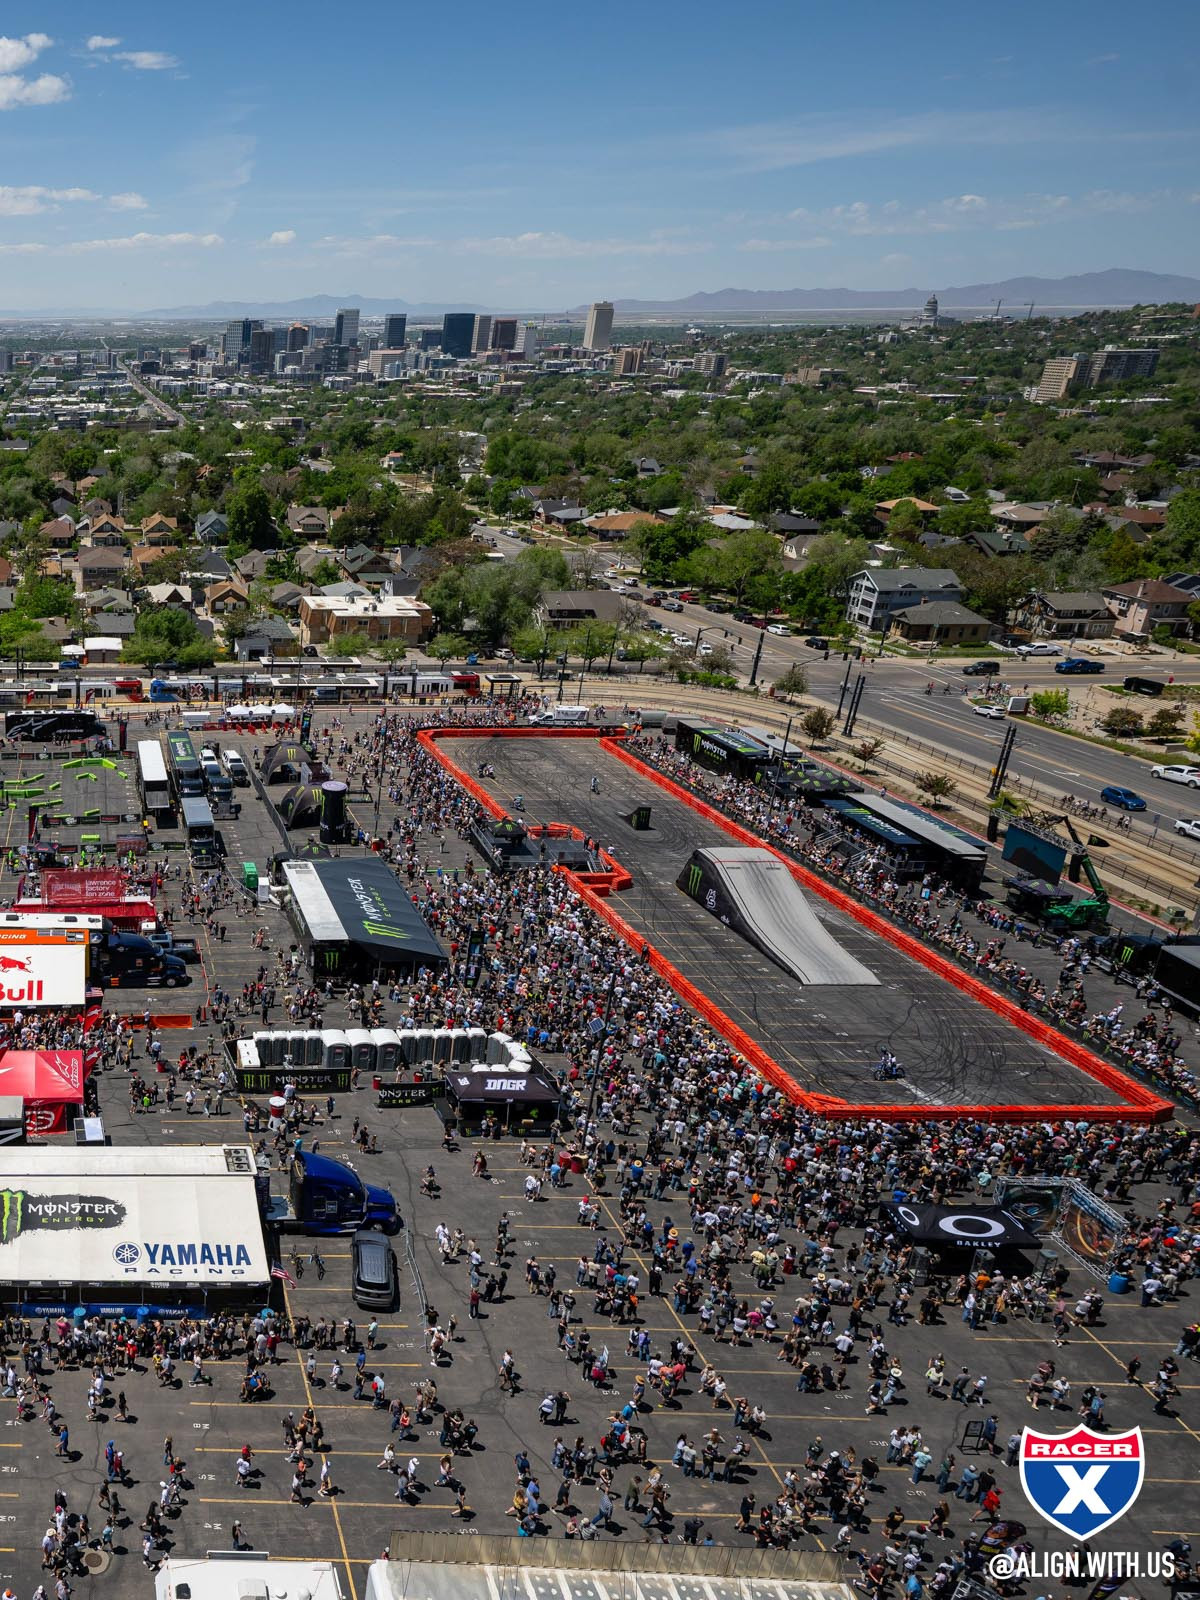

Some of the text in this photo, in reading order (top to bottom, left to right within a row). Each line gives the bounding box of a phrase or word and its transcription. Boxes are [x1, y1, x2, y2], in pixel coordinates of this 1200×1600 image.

[348, 878, 382, 921] MONSTER
[275, 1075, 332, 1084] MONSTER
[485, 1079, 527, 1091] DNGR
[27, 1202, 118, 1216] MONSTER
[956, 1240, 1002, 1248] OAKLEY
[143, 1243, 252, 1265] YAMAHA
